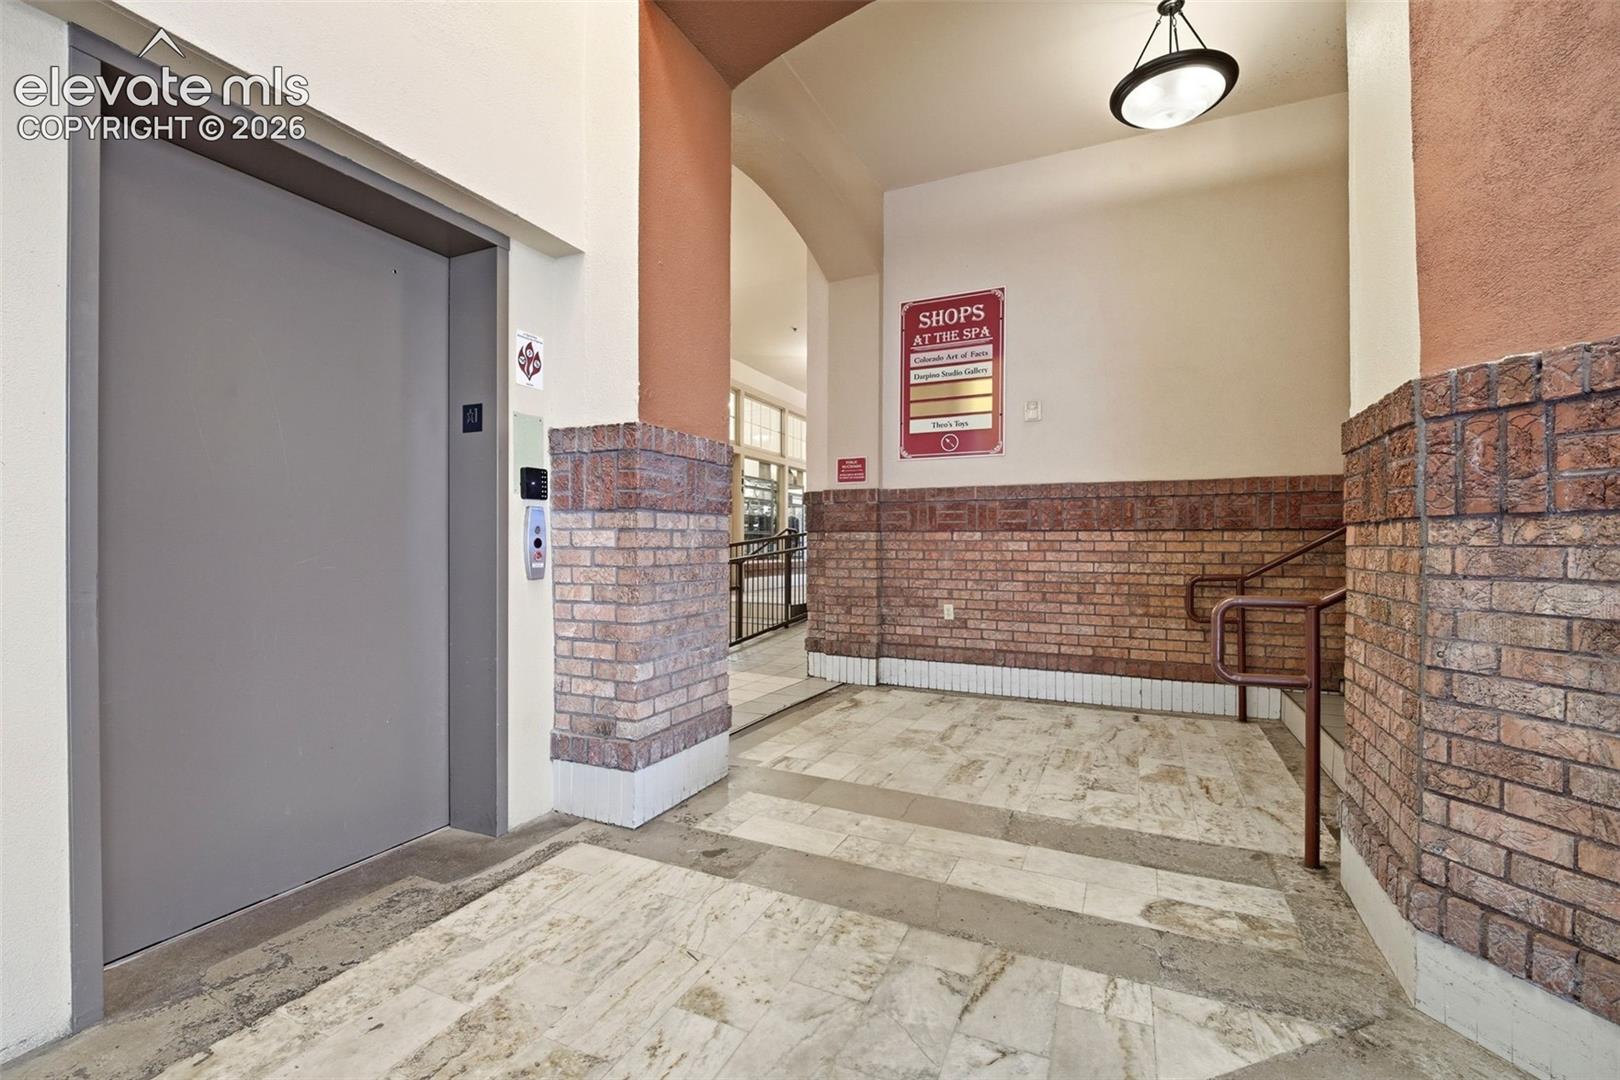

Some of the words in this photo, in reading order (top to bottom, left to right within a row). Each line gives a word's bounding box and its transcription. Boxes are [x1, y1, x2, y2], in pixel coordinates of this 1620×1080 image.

[918, 304, 985, 329] SHOPS
[912, 334, 932, 346] AT
[933, 330, 960, 343] THE
[962, 326, 990, 340] SPA
[913, 354, 944, 364] Colorado
[945, 353, 958, 361] Art
[970, 350, 988, 358] Facts
[941, 369, 963, 378] Studio
[964, 367, 988, 376] Gallery
[931, 421, 953, 429] Theo's
[954, 420, 969, 428] Toys
